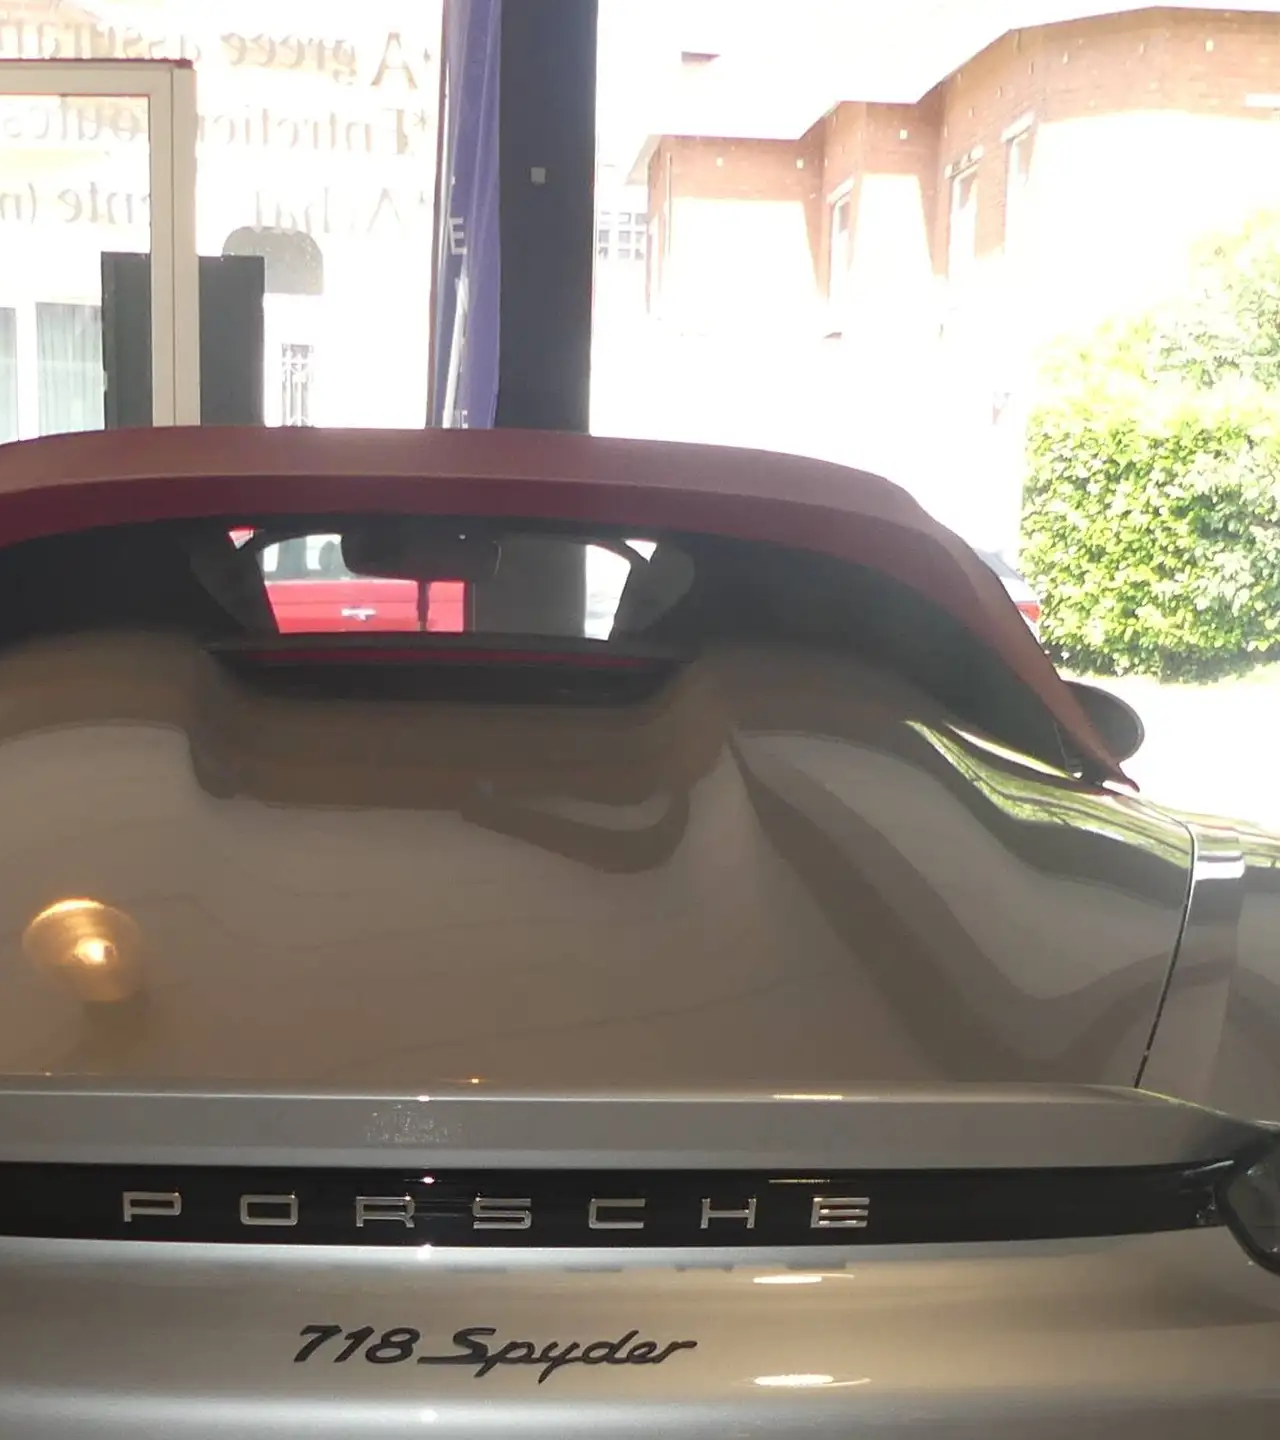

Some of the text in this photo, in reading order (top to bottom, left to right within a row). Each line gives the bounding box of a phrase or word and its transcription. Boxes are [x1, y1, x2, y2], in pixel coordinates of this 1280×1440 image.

[122, 1189, 871, 1230] PORSCHE
[293, 1324, 698, 1385] 718 Spyder
